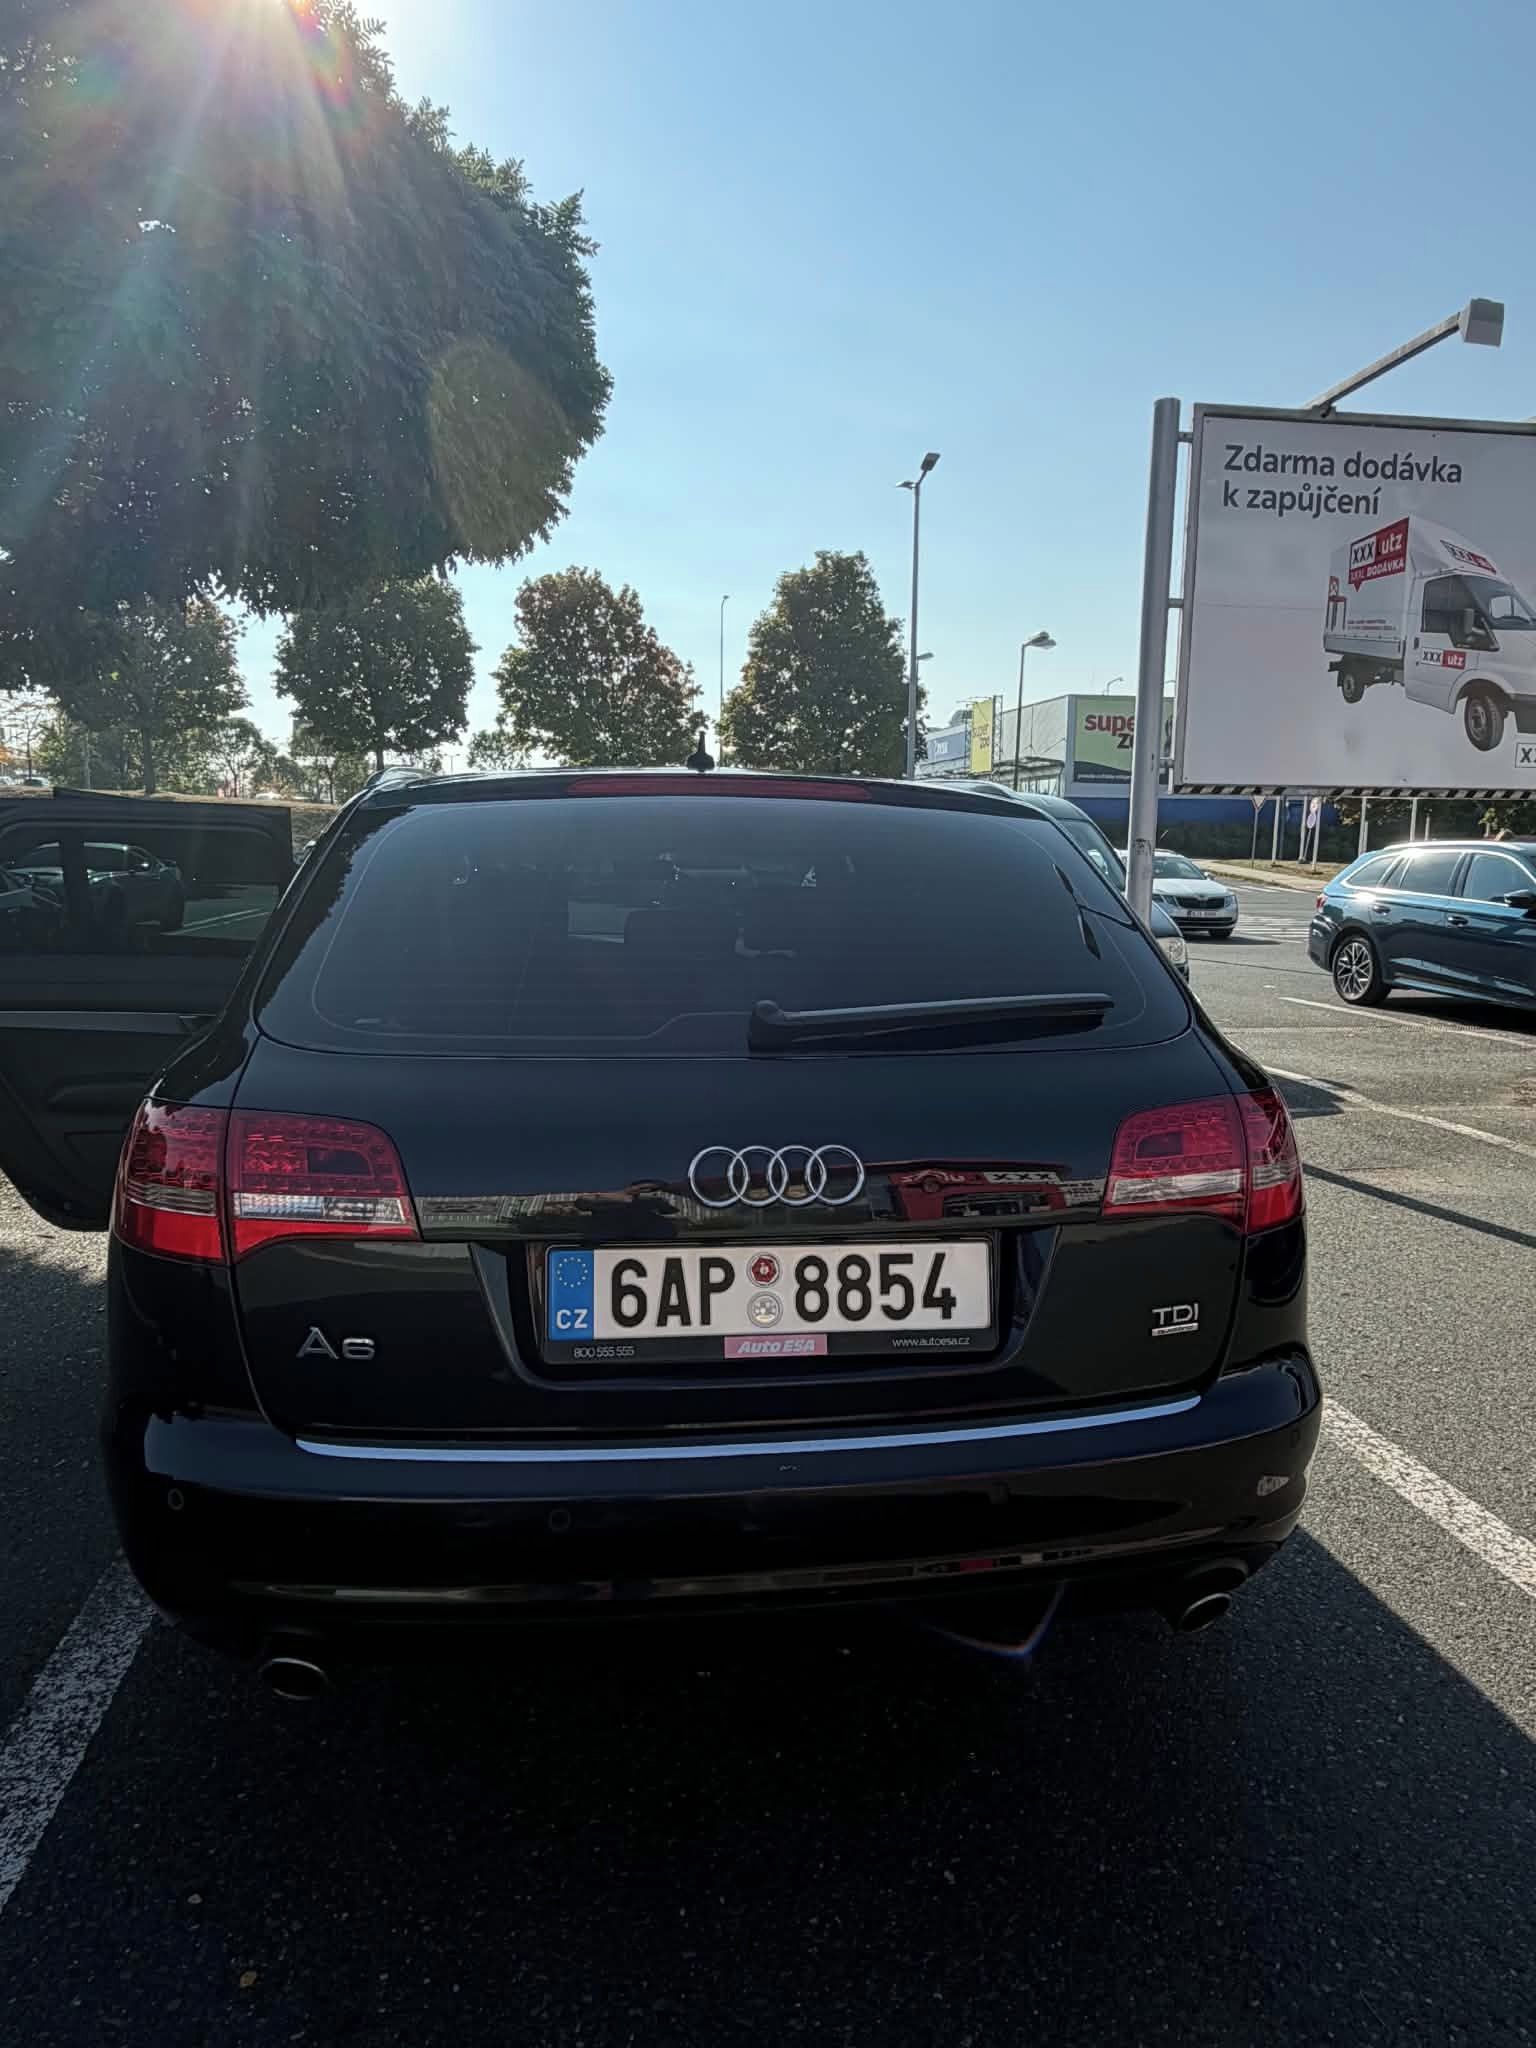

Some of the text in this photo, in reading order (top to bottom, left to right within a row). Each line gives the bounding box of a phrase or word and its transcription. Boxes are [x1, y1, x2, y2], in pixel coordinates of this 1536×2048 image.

[1223, 444, 1463, 483] Zdarma dodávka
[1223, 480, 1382, 519] k zapůjčení
[1084, 713, 1135, 735] supe
[610, 1253, 957, 1328] 6AP 8854
[556, 1308, 588, 1330] CZ
[1152, 1302, 1200, 1326] TDI
[296, 1326, 375, 1361] A6
[574, 1345, 634, 1358] 800 555 555
[783, 1339, 816, 1352] ESA
[892, 1336, 971, 1348] www.autoesa.cz
